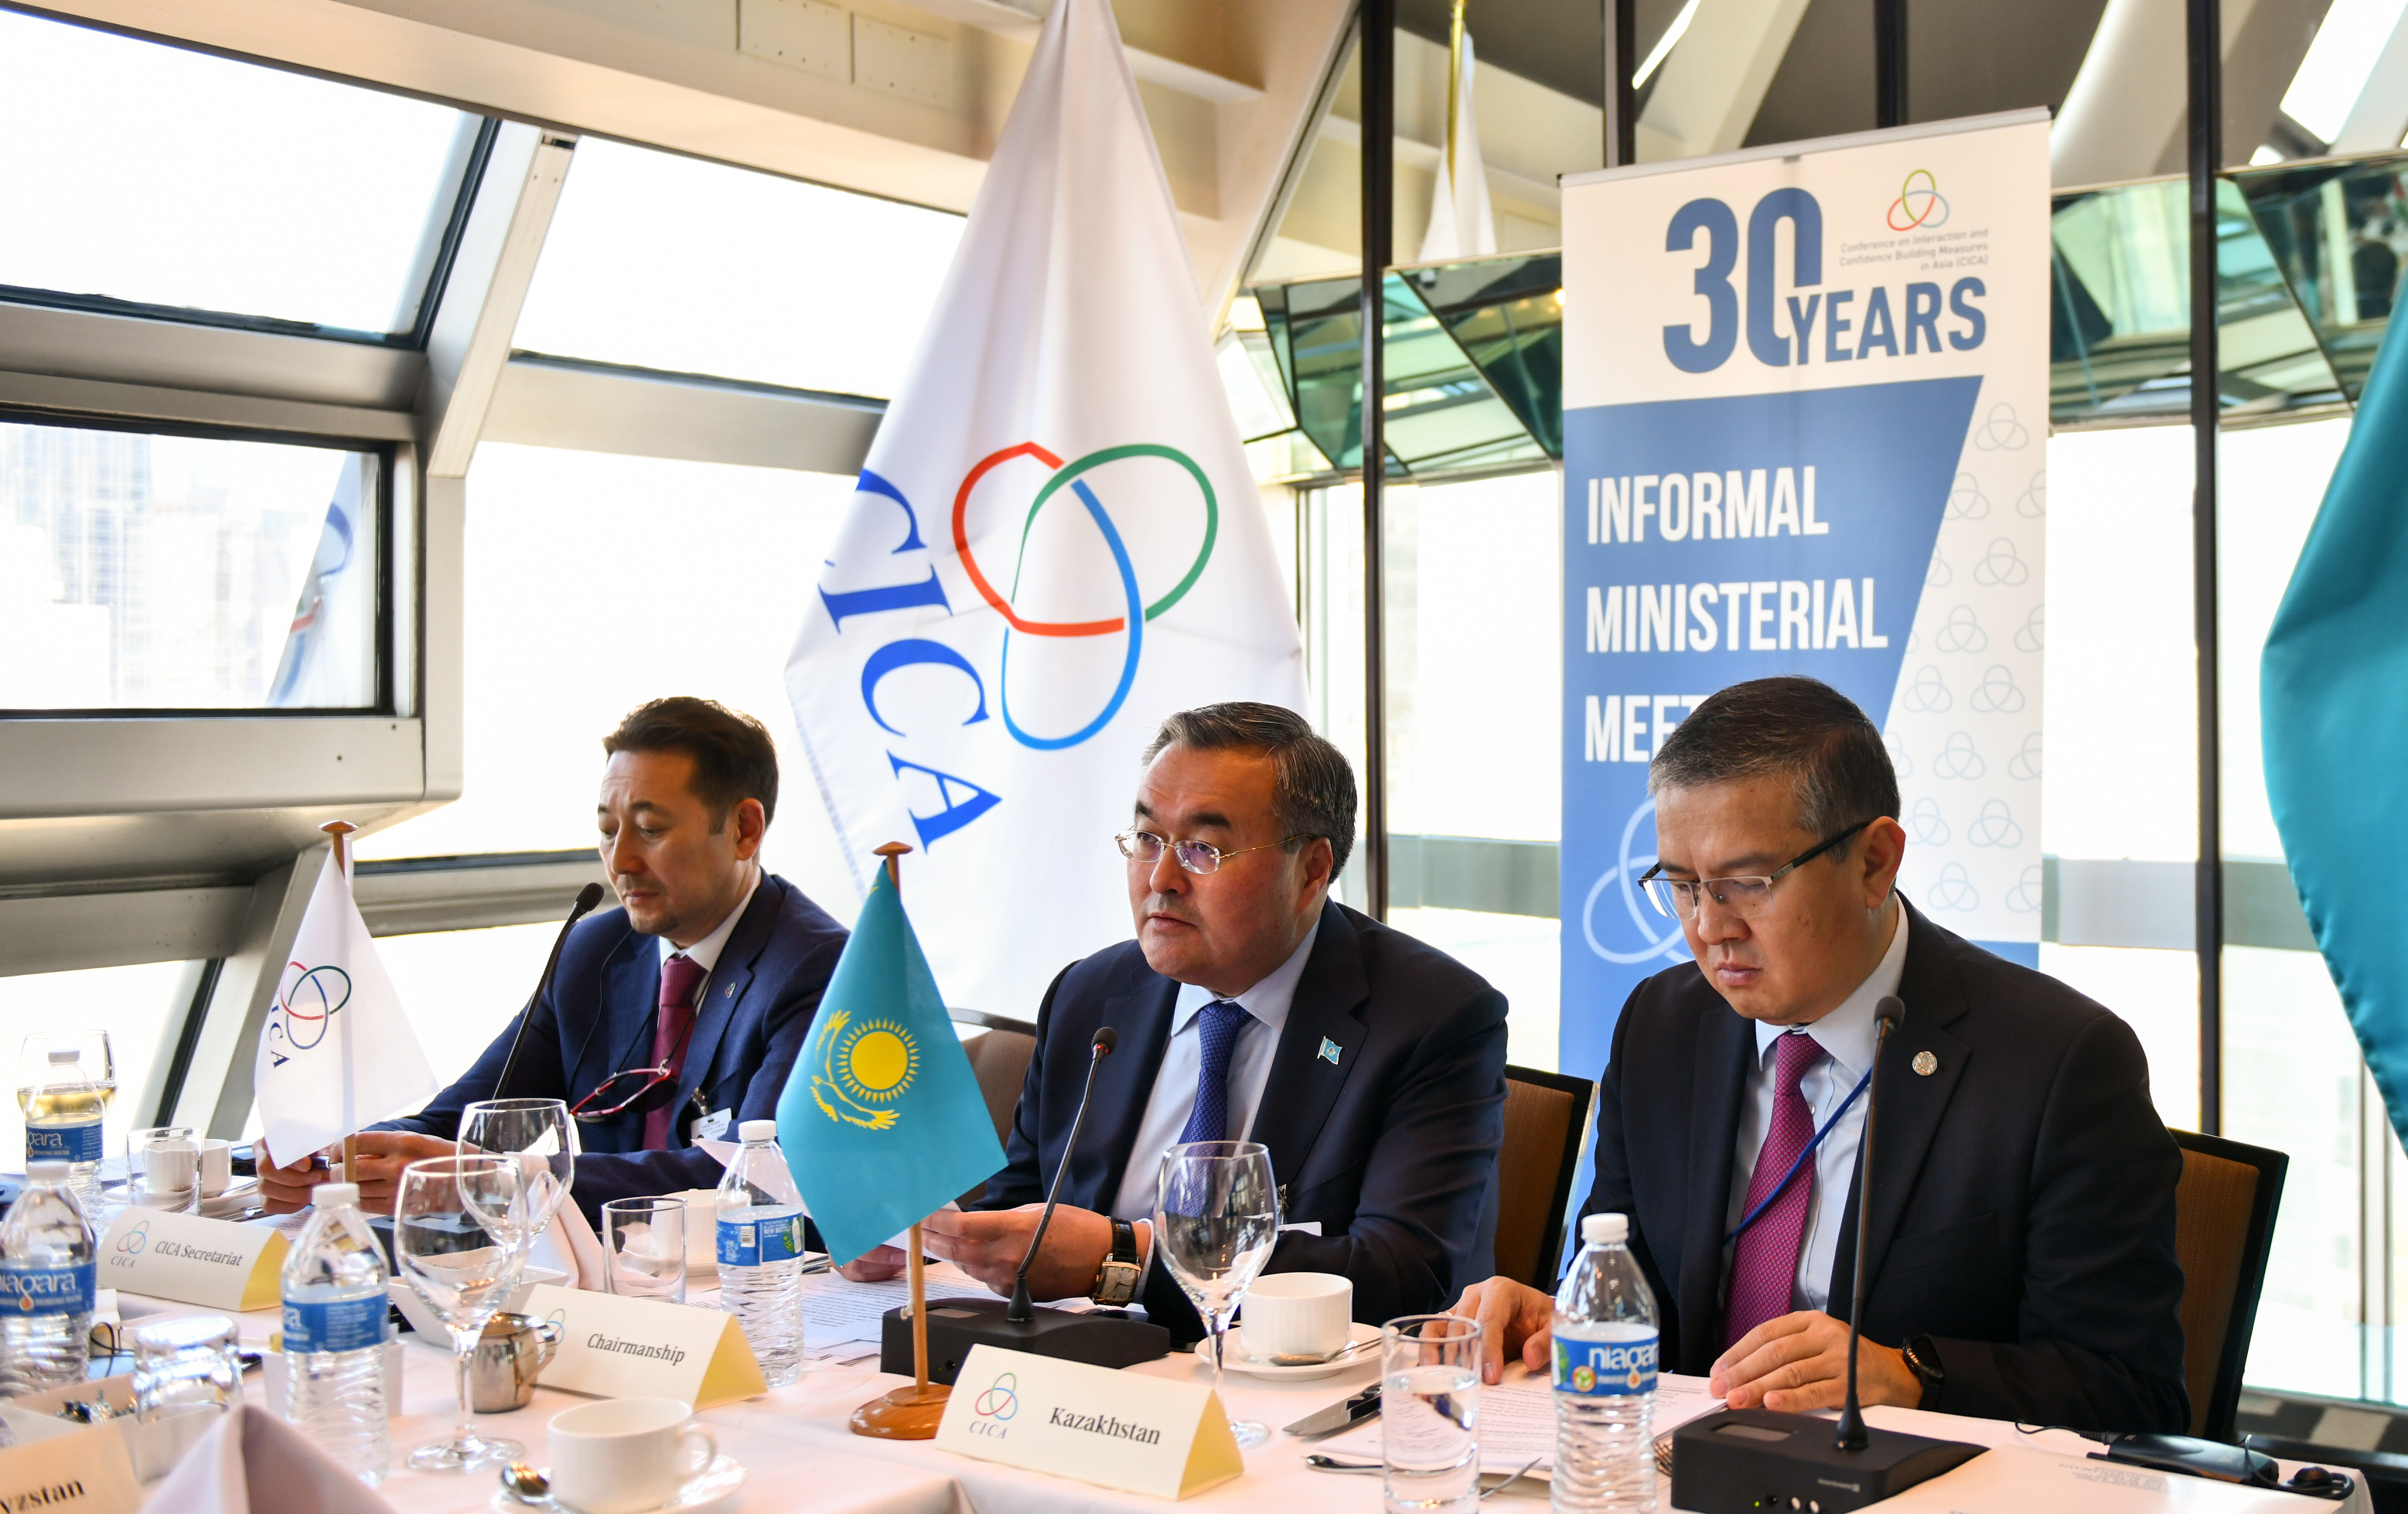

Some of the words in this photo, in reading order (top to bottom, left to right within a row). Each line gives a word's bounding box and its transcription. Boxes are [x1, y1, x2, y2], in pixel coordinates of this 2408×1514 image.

[1840, 239, 1895, 253] Conference
[1913, 230, 1967, 244] Interaction
[1970, 228, 1989, 238] and
[1840, 253, 1893, 267] Confidence
[1895, 248, 1936, 261] Building
[1939, 243, 1988, 255] Measures
[1921, 261, 1930, 271] in
[1933, 259, 1953, 270] Asia
[1663, 186, 1823, 373] 30
[1786, 276, 1987, 366] YEARS
[1588, 465, 1829, 544] INFORMAL
[1586, 578, 1888, 653] MINISTERIAL
[111, 1256, 136, 1268] CICA
[155, 1240, 182, 1257] CICA
[181, 1245, 244, 1267] Secretariat
[587, 1333, 685, 1366] Chairmanship
[969, 1420, 1009, 1440] CICA
[1049, 1407, 1161, 1445] Kazakhstan
